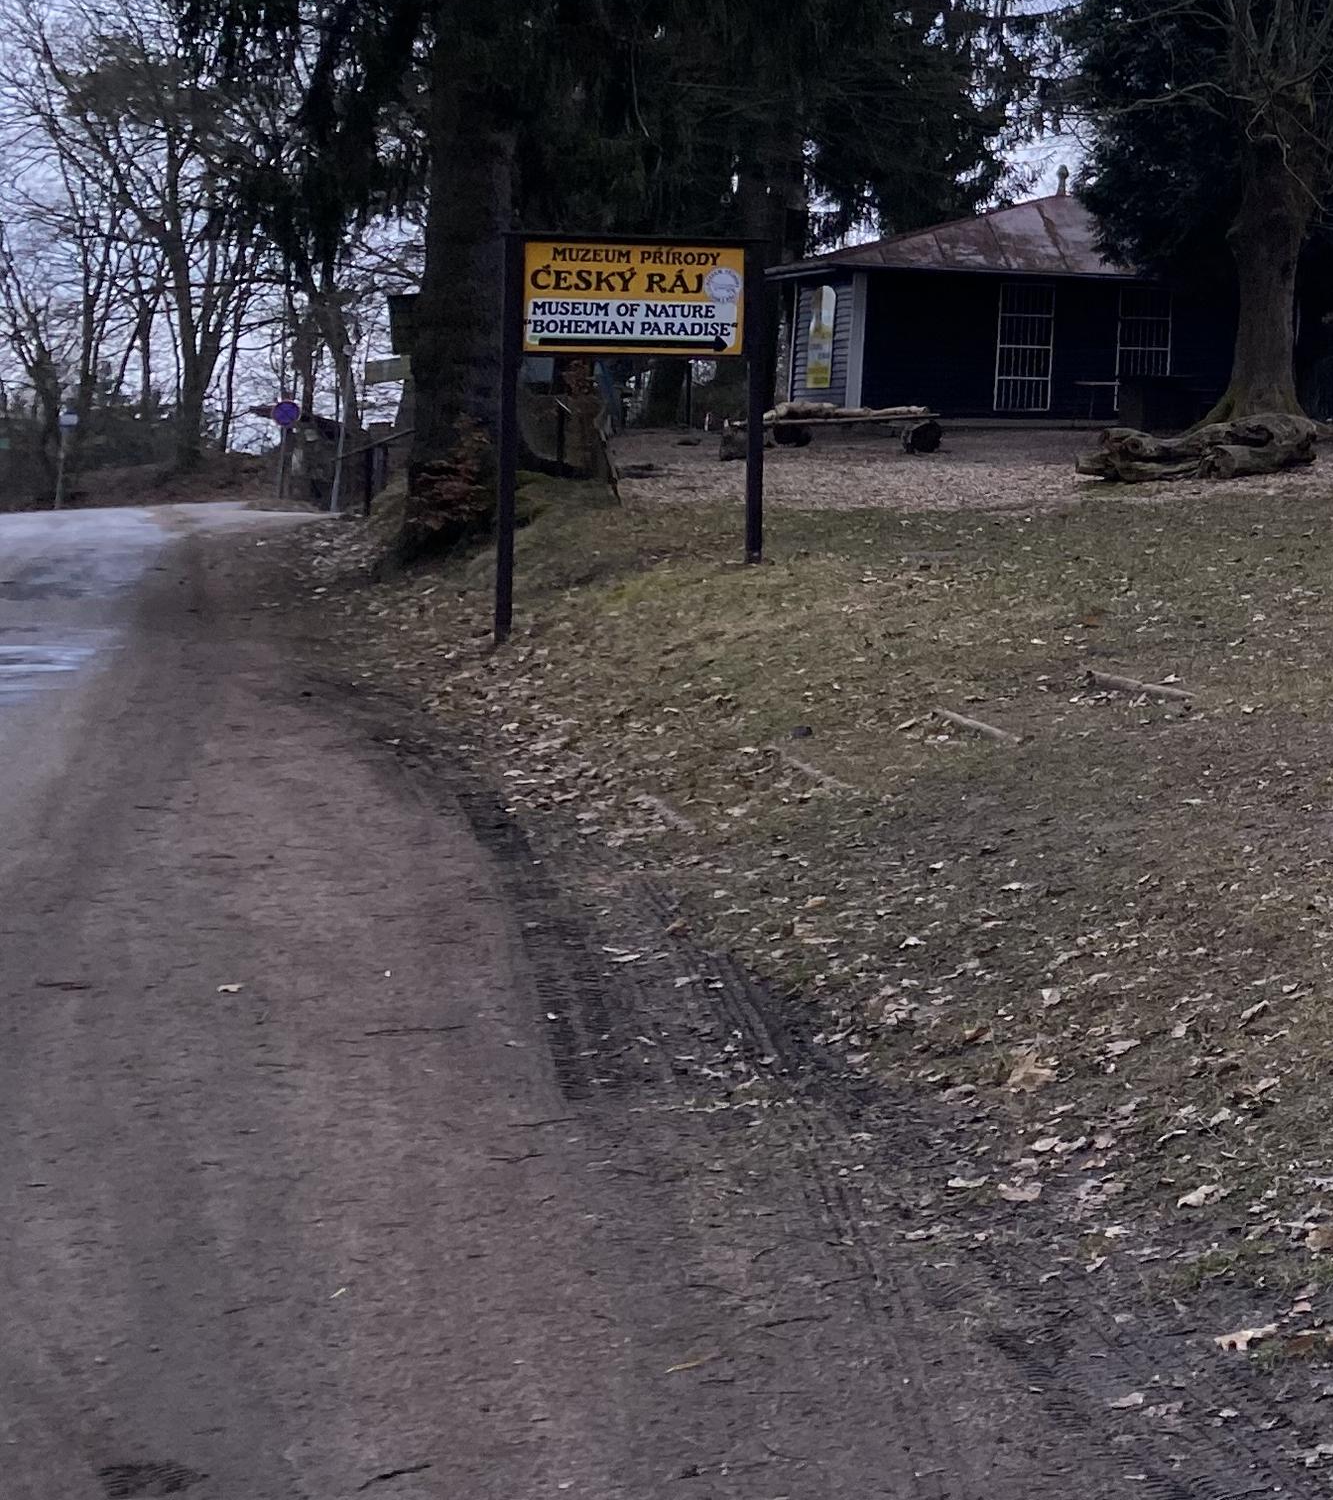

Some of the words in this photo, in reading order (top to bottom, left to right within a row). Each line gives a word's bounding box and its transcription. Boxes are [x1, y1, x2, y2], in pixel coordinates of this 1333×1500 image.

[552, 246, 632, 264] MUZEUM
[640, 246, 720, 266] PŘÍRODY
[530, 264, 637, 292] ČESKÝ
[645, 269, 703, 293] RÁJ
[532, 301, 609, 317] MUSEUM
[616, 302, 640, 317] OF
[645, 303, 715, 319] NATURE
